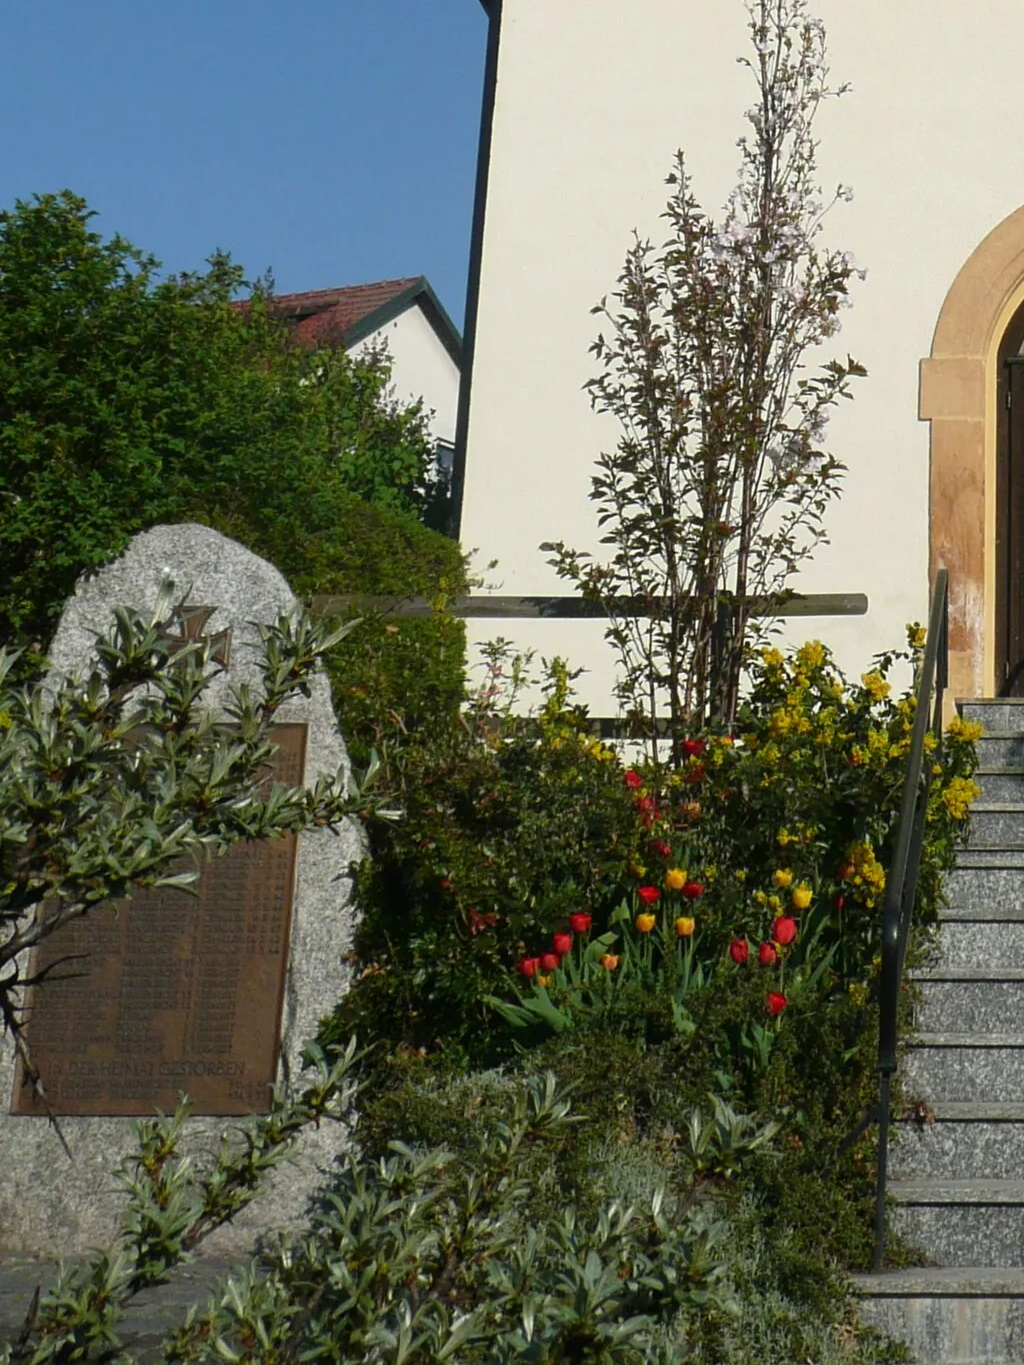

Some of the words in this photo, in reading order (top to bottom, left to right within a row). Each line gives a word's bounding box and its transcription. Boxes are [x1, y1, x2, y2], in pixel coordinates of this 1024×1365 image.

[68, 1061, 96, 1076] DER
[102, 1061, 156, 1077] HEIMAT
[158, 1061, 246, 1077] GESTORBEN
